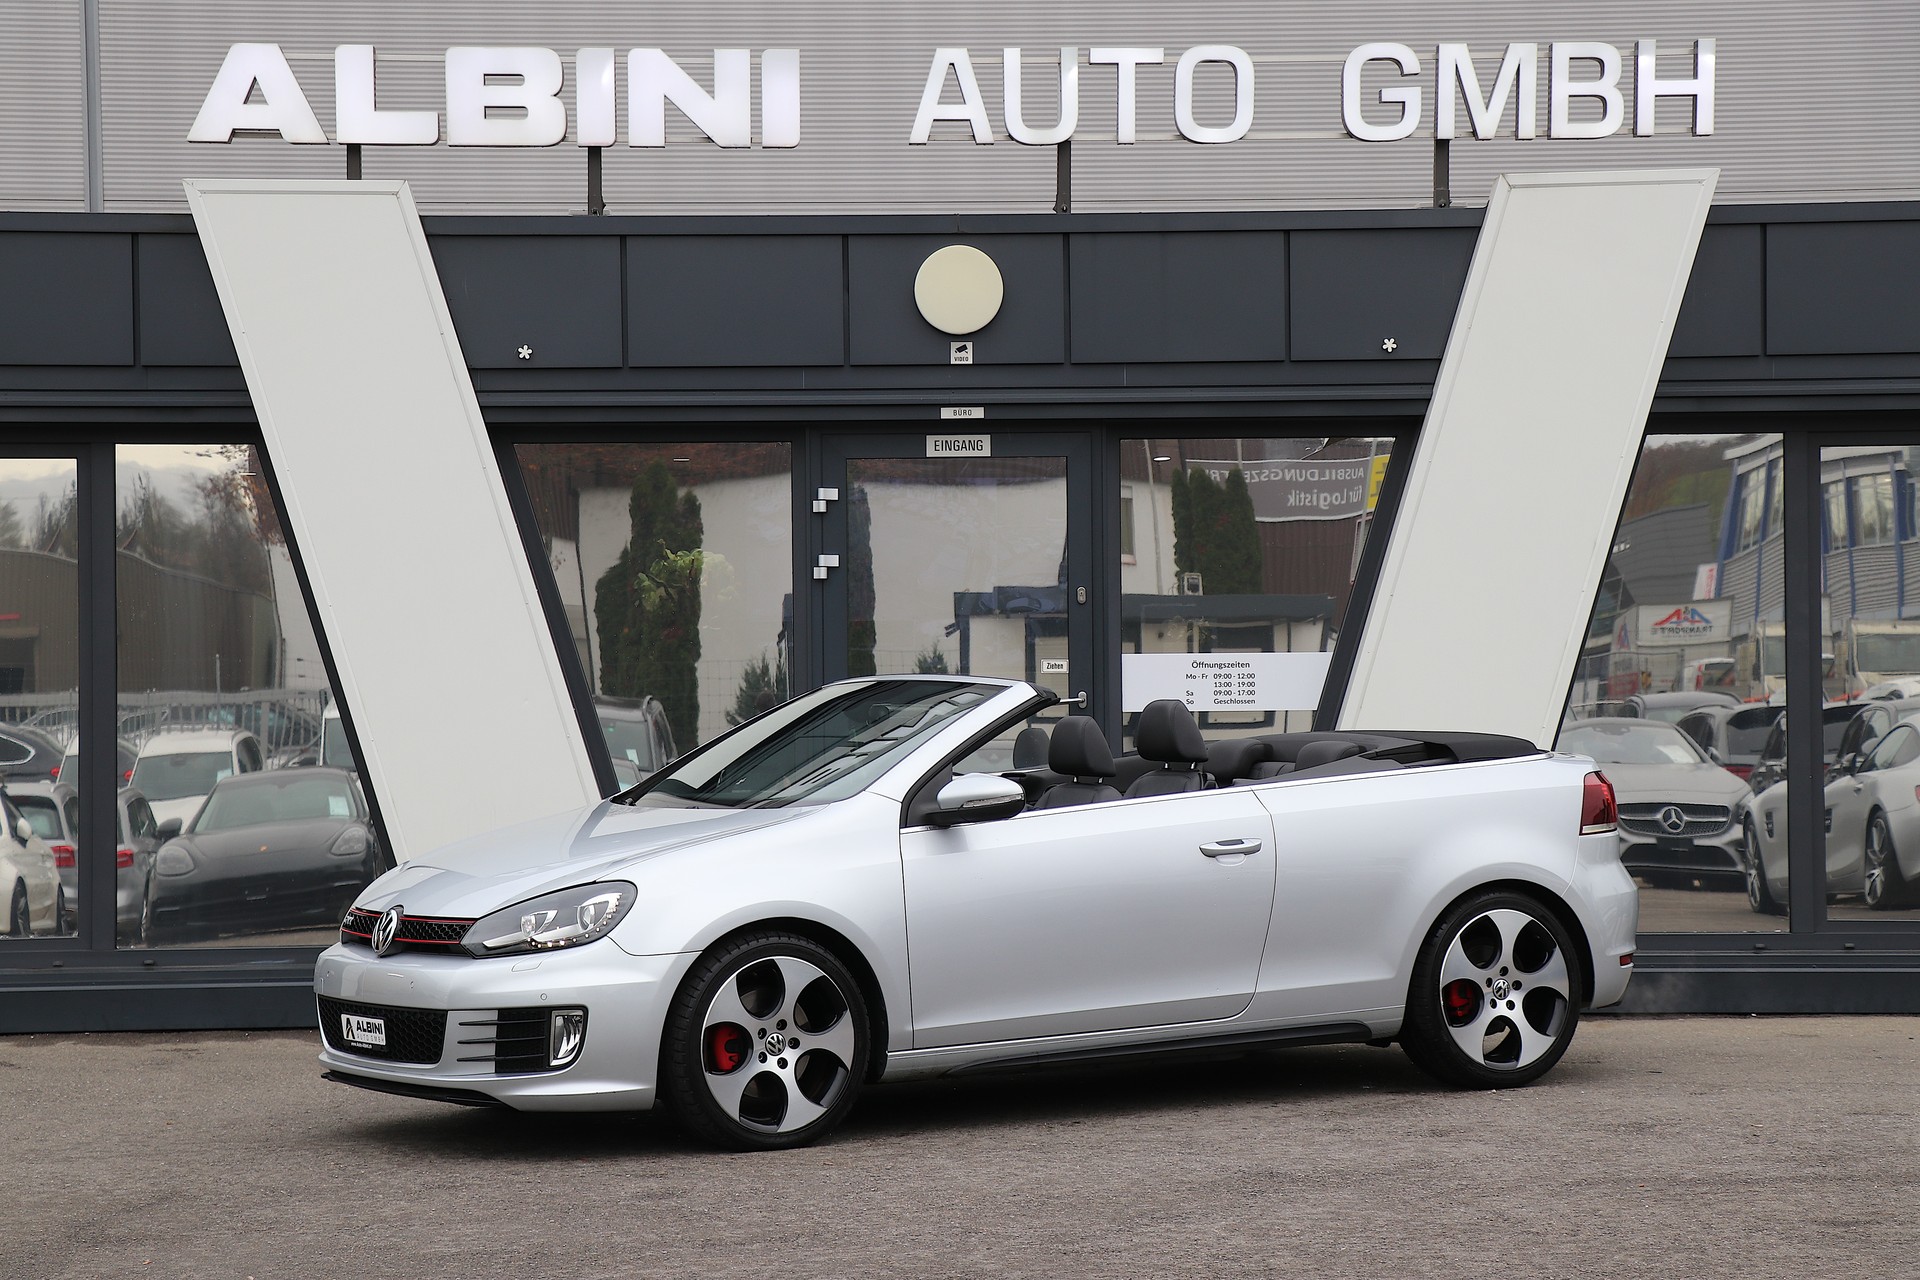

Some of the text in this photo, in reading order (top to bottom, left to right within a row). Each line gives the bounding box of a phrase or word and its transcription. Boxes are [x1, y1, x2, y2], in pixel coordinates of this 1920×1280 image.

[187, 38, 1717, 149] ALBINI AUTO GMBH
[952, 407, 973, 416] BÜRO
[934, 439, 984, 451] EINGANG
[1046, 662, 1064, 670] Ziehen
[1191, 660, 1250, 670] Öffnungszeiten
[356, 1019, 384, 1035] ALBINI
